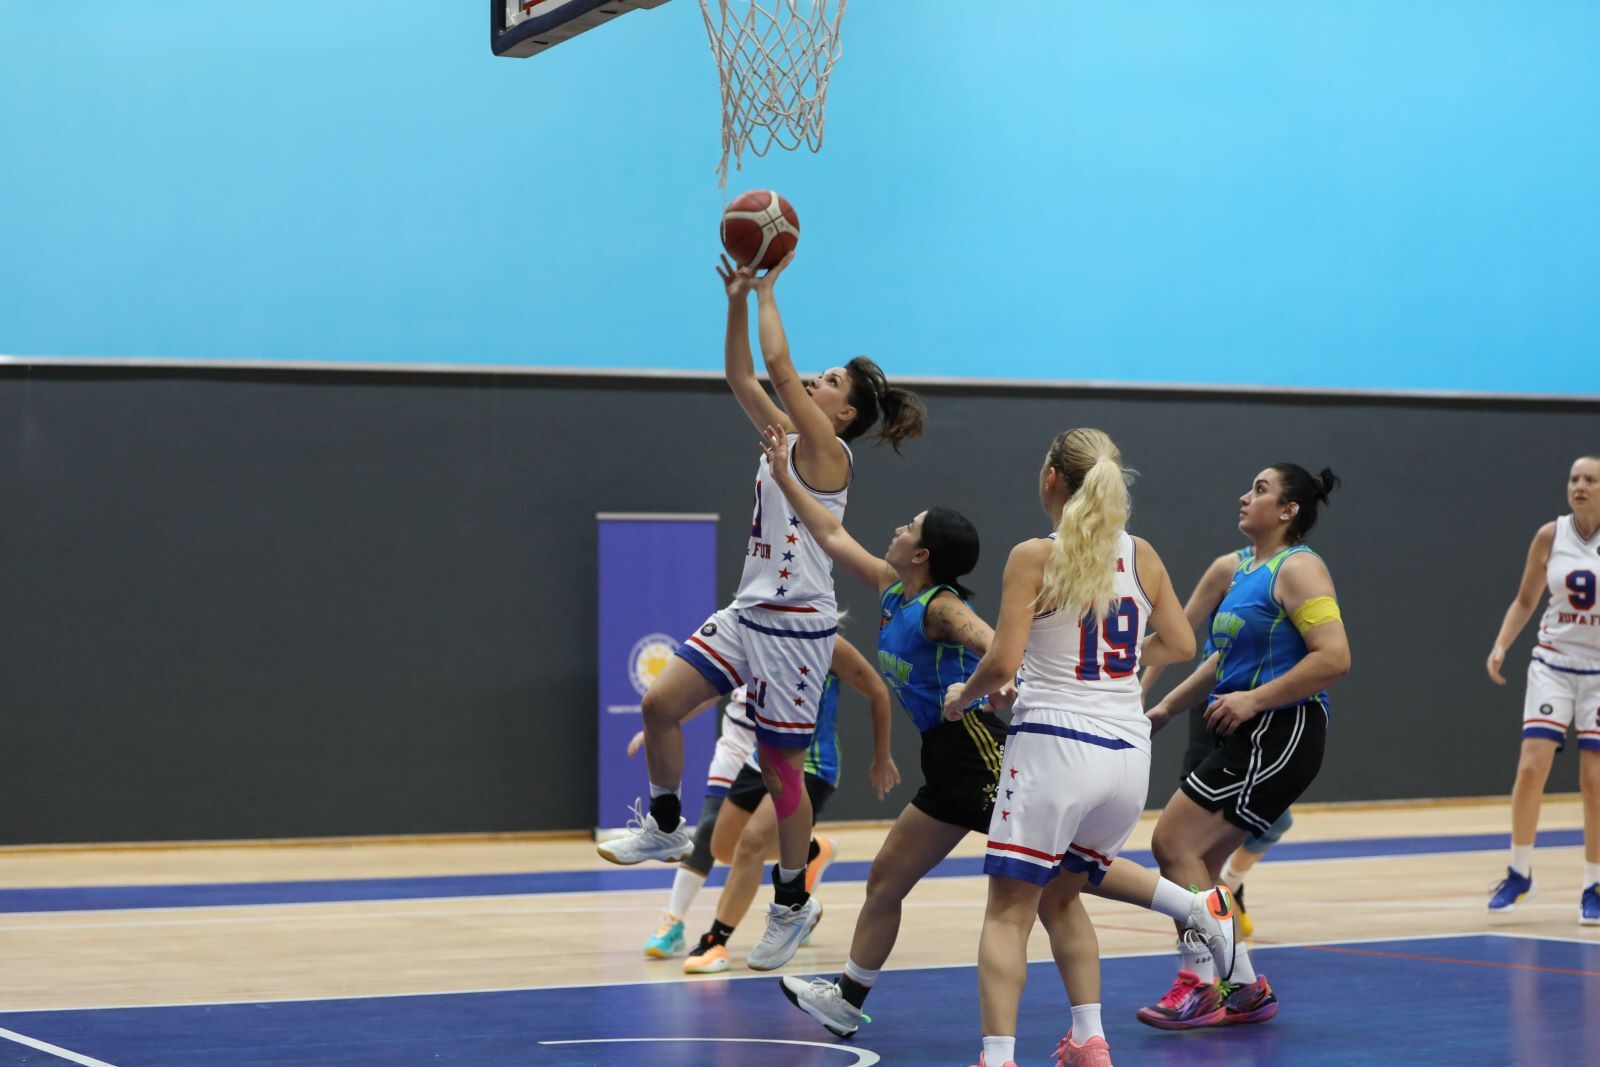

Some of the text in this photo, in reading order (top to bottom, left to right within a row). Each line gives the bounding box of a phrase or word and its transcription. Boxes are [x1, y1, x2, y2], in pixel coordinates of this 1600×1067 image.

[752, 542, 771, 560] FUN
[1565, 570, 1597, 611] 9
[1075, 596, 1139, 681] 19
